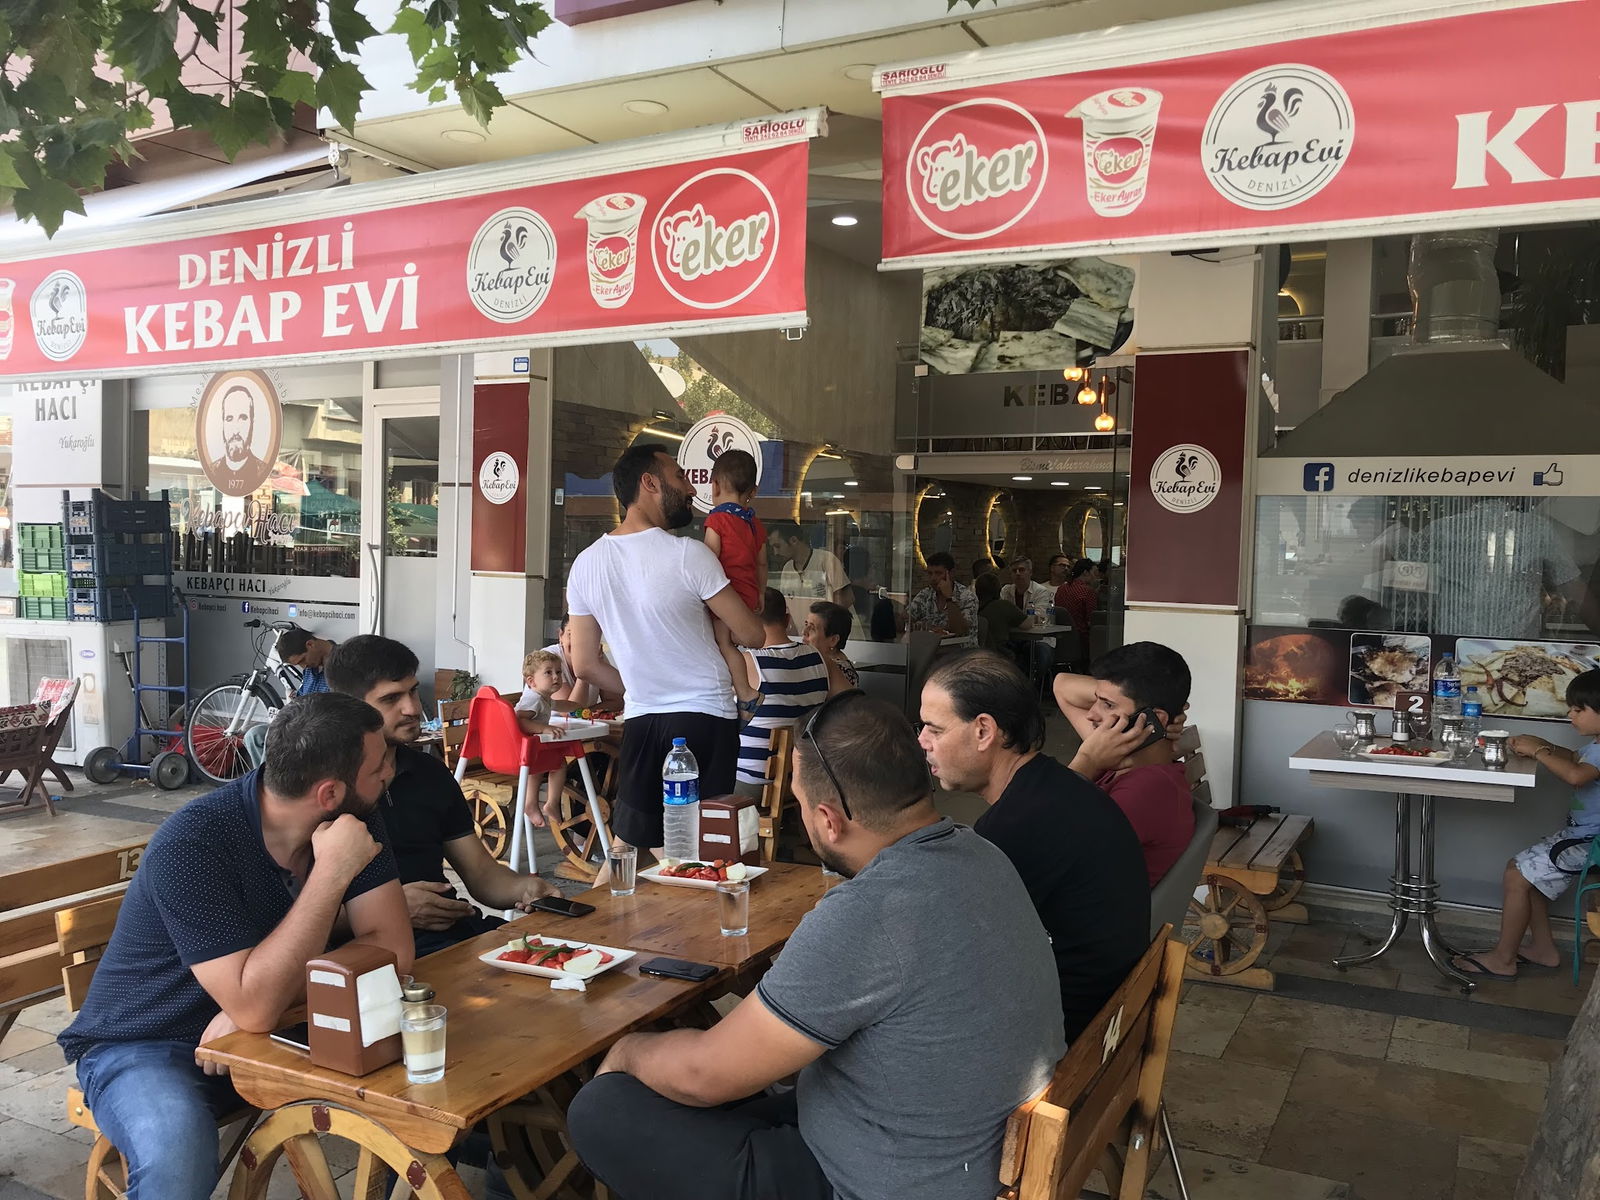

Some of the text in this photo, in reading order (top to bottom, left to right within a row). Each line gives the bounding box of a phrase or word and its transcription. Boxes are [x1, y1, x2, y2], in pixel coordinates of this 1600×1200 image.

[1103, 152, 1141, 174] eker
[939, 146, 1034, 207] eker
[178, 221, 356, 291] DENİZLİ
[682, 217, 767, 276] eker
[601, 250, 629, 270] eker
[123, 262, 420, 354] KEBAP EVİ
[35, 396, 77, 421] HACI
[228, 480, 244, 489] 1977
[1347, 467, 1516, 486] denizlikebapevi
[186, 577, 234, 593] KEBAPÇI
[239, 578, 266, 592] HACI
[1408, 695, 1424, 713] 2
